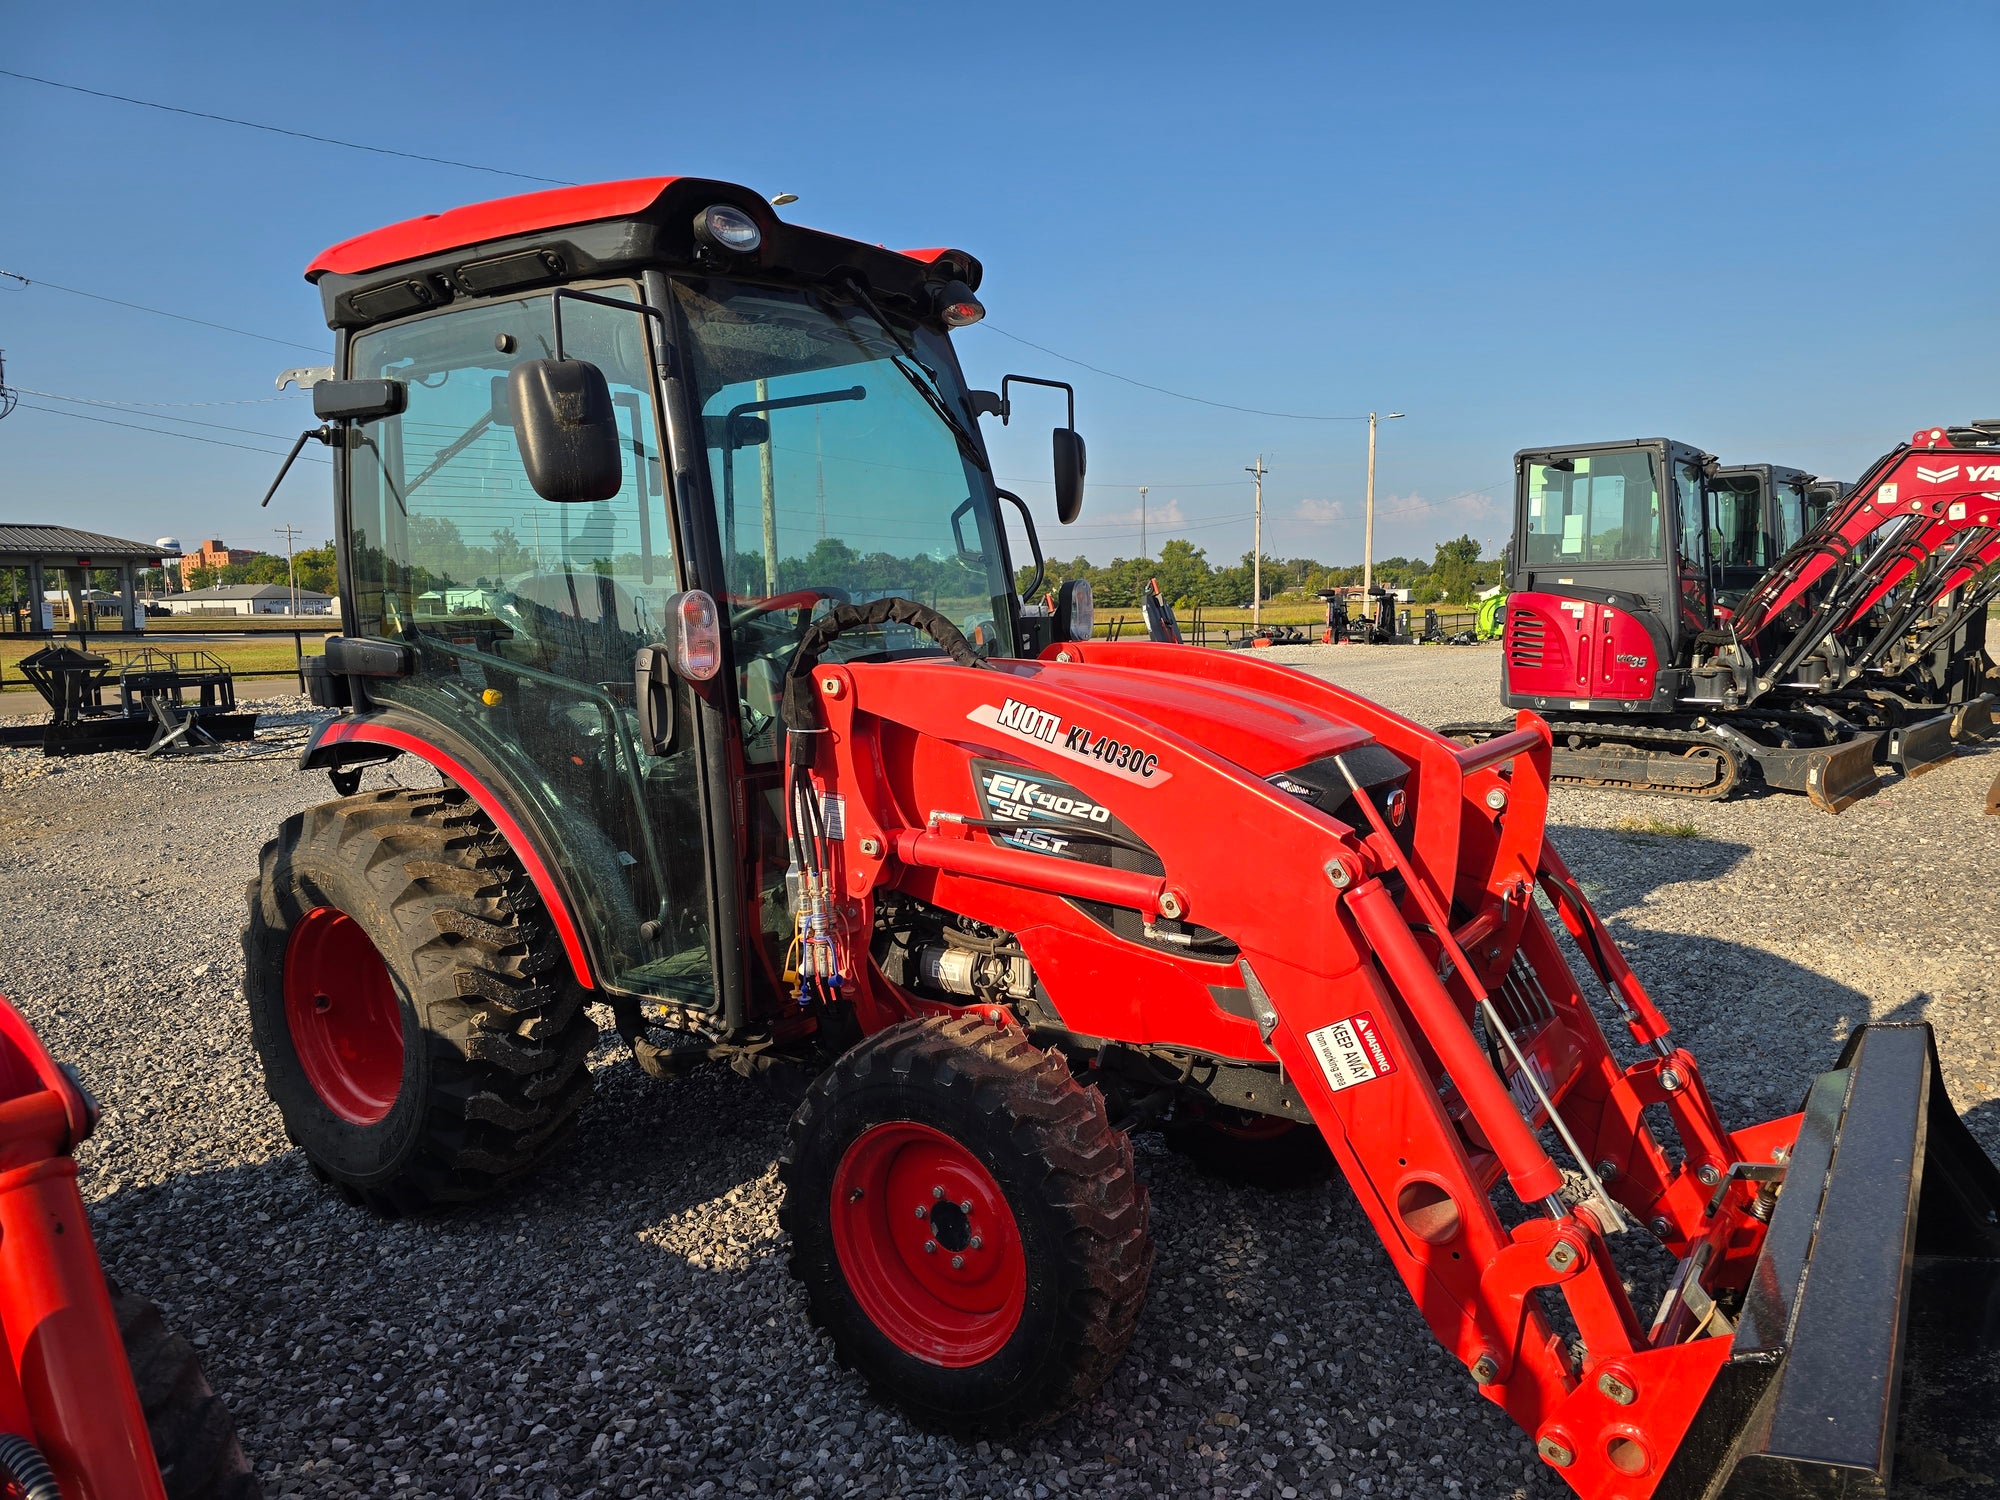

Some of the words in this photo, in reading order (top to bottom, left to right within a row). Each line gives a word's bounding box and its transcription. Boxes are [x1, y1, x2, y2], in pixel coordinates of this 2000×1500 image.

[997, 697, 1062, 744] KIOTI
[1065, 725, 1158, 778] KL4030C
[988, 774, 1110, 823] CK4020
[996, 799, 1033, 821] SE
[1013, 828, 1069, 854] HST
[1315, 1031, 1327, 1046] from
[1322, 1046, 1340, 1073] working
[1333, 1071, 1346, 1086] area
[1331, 1023, 1354, 1049] KEEP
[1343, 1051, 1369, 1080] AWAY
[1363, 1030, 1391, 1072] WARNING
